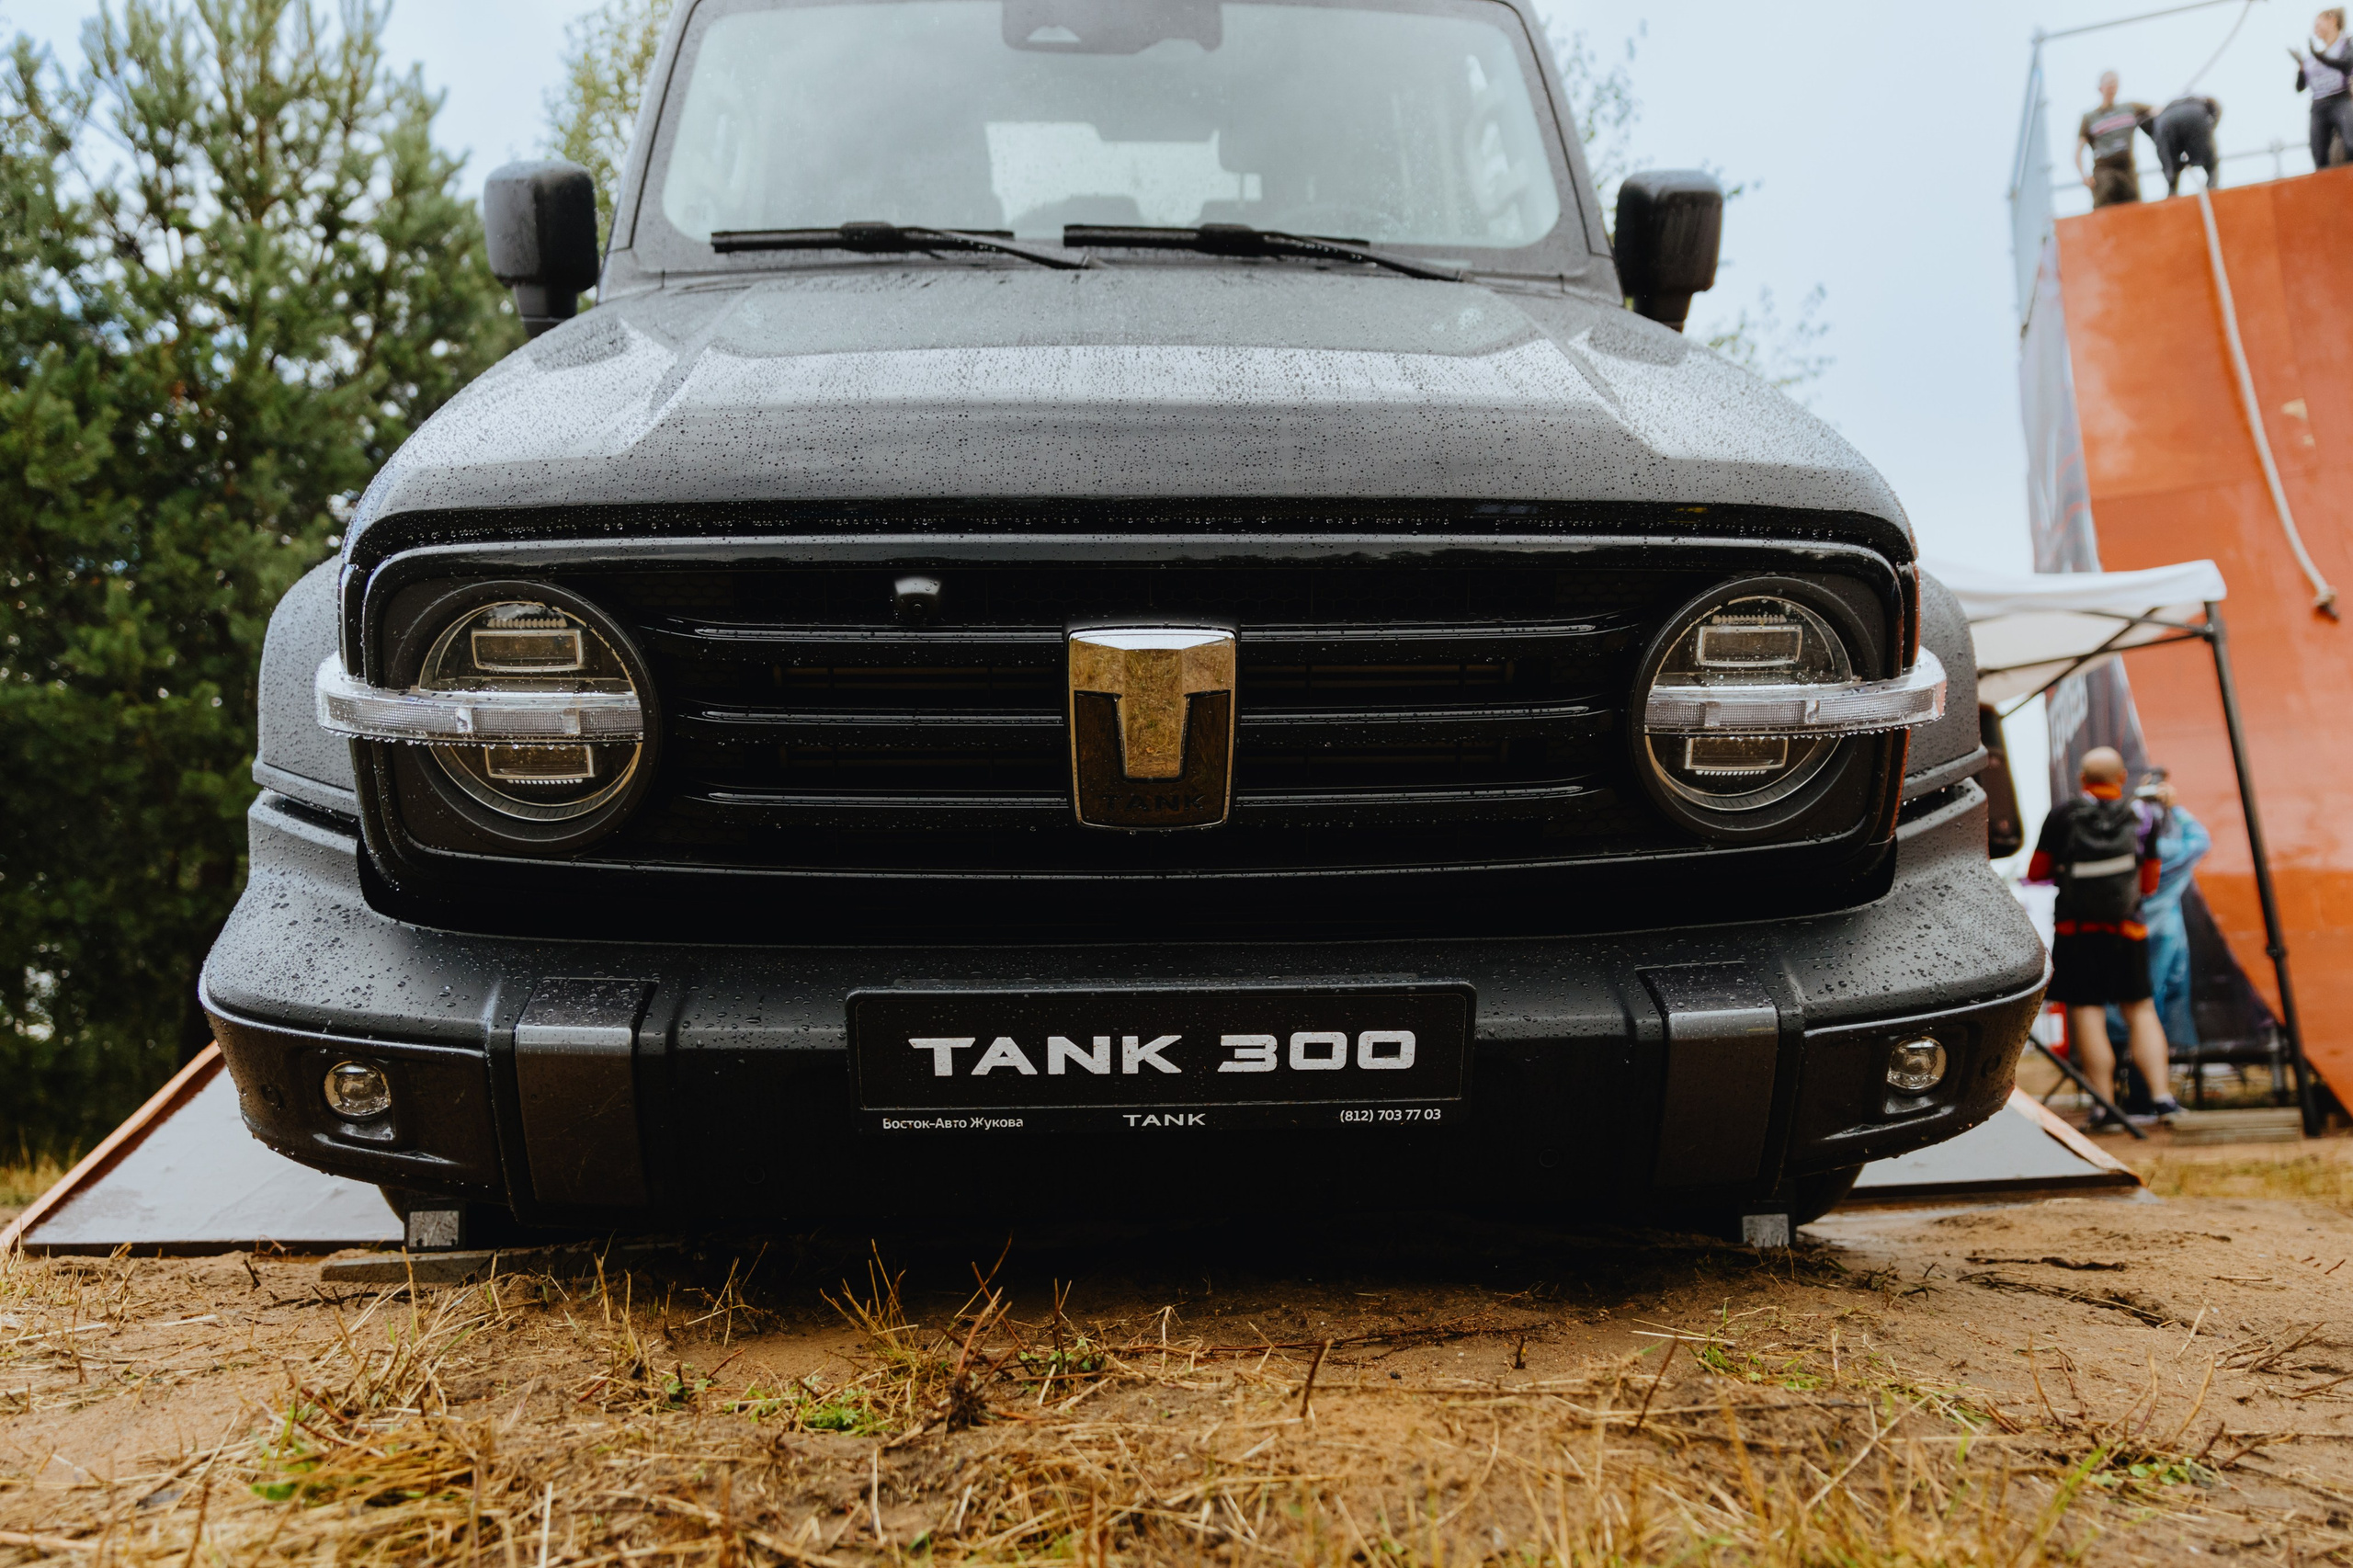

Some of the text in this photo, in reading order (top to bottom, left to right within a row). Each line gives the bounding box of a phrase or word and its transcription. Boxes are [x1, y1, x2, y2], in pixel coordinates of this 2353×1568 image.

[1101, 794, 1206, 812] TANK
[907, 1029, 1416, 1077] TANK 300
[1122, 1113, 1206, 1127] TANK
[1339, 1108, 1441, 1123] (812) 703 77 03
[882, 1117, 1024, 1131] Восток-Авто Жукова
